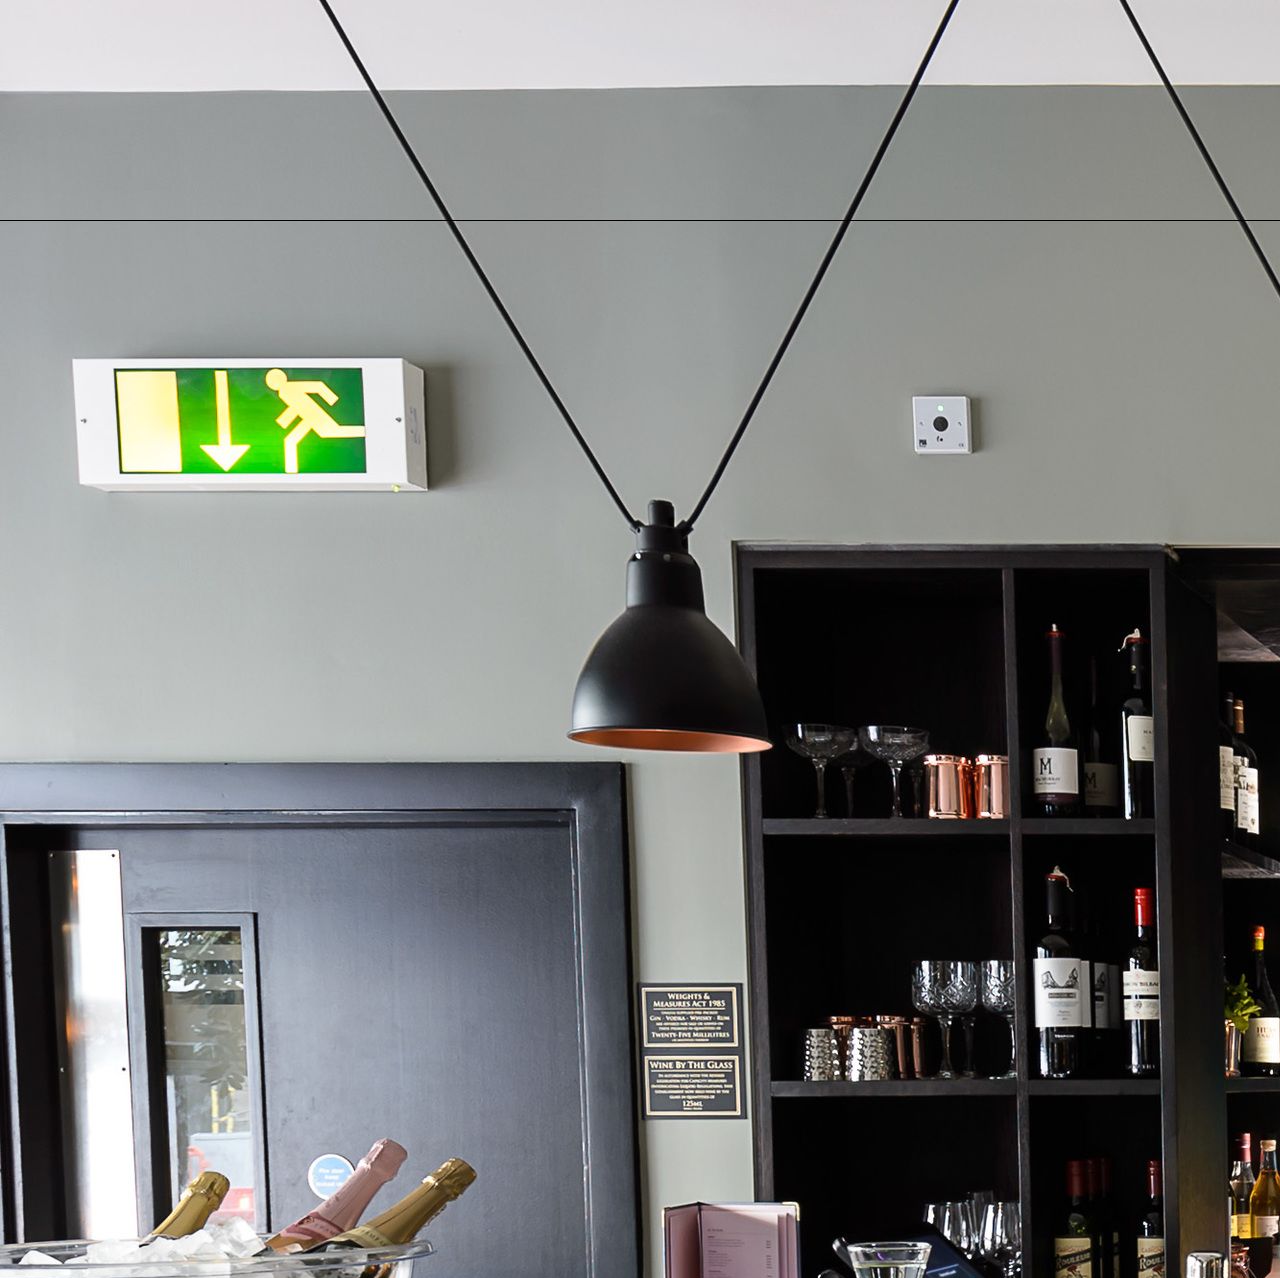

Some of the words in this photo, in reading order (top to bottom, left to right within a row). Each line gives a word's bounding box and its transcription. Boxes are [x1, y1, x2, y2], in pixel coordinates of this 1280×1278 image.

[650, 1060, 674, 1068] WINE
[676, 1060, 686, 1068] BY
[687, 1060, 706, 1068] THE
[707, 1060, 733, 1068] GLASS
